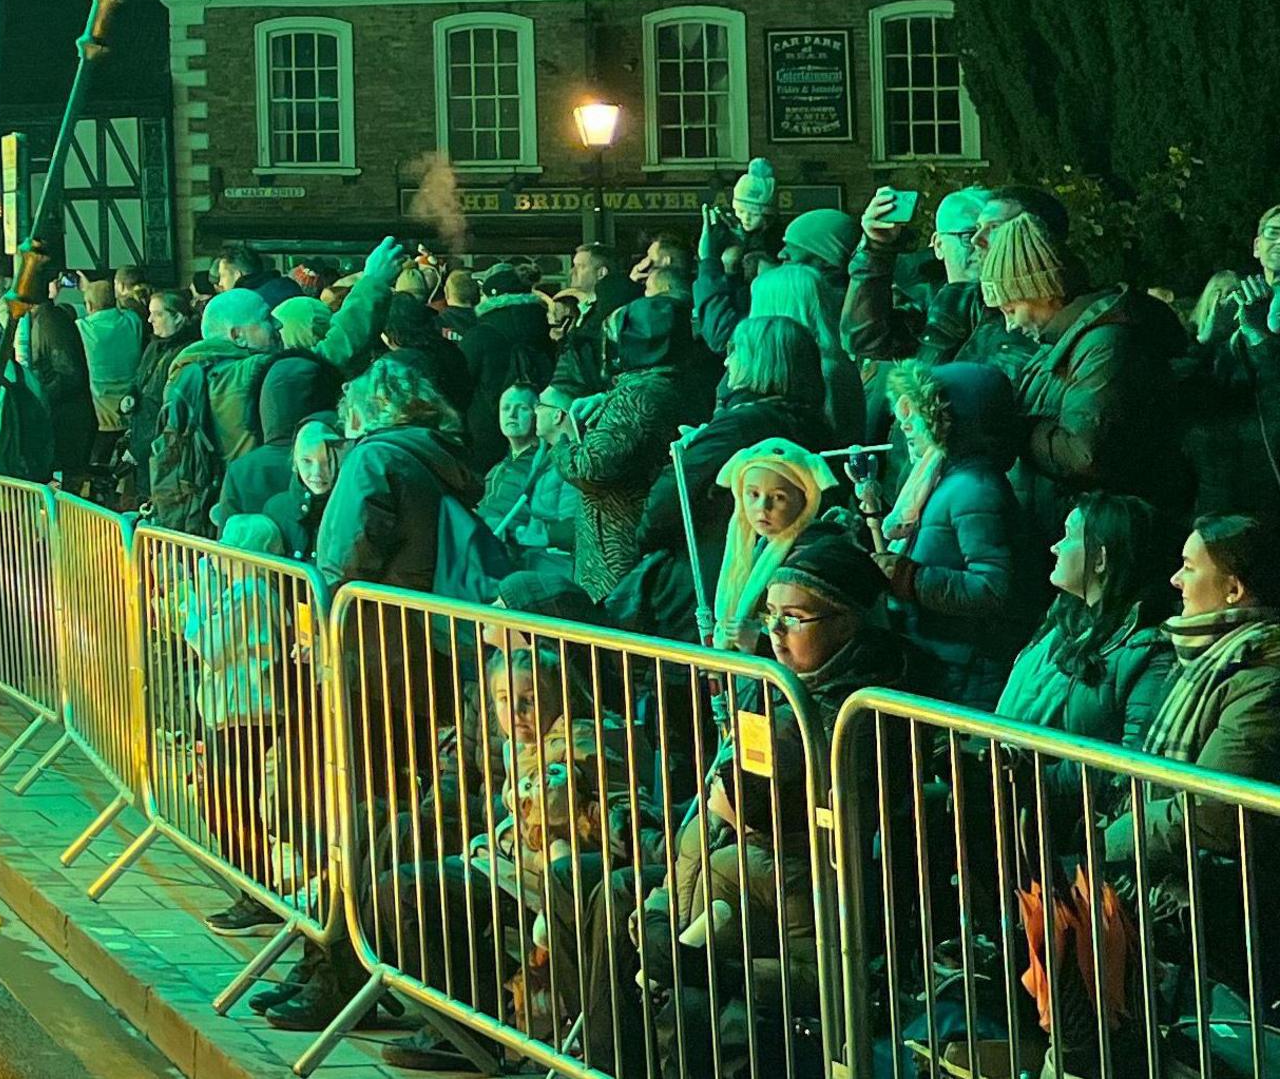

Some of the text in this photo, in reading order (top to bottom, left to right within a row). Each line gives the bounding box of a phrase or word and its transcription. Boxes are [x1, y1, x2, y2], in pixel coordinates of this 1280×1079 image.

[773, 36, 842, 52] CAR PARK
[780, 120, 841, 134] GARDEN
[714, 191, 793, 209] AS
